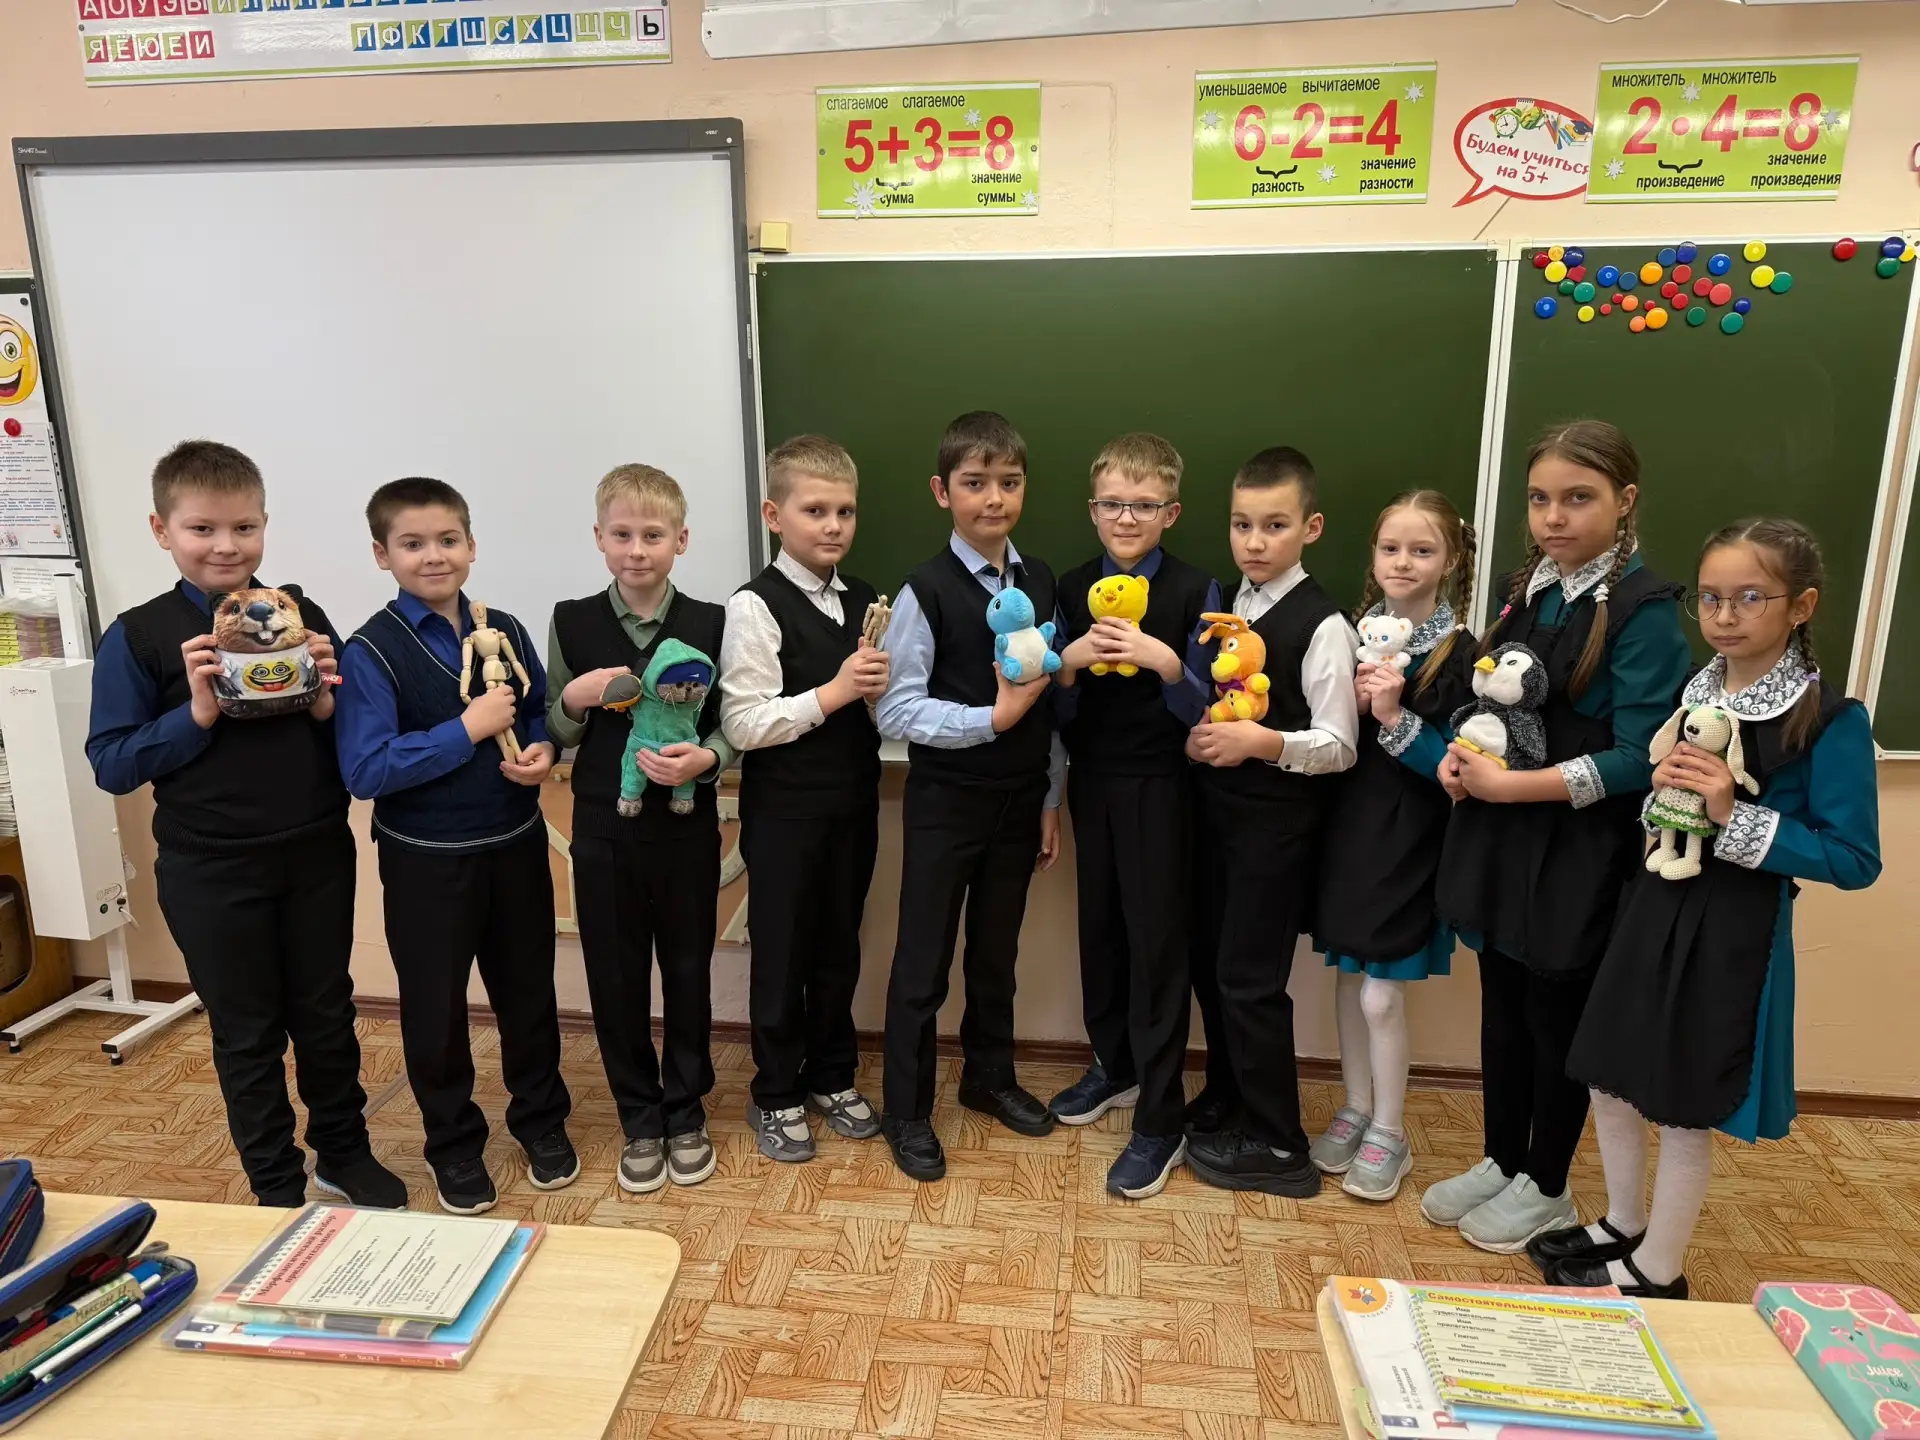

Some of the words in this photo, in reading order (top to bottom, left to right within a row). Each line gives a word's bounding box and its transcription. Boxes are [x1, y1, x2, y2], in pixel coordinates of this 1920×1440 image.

[1612, 72, 1686, 88] множитель
[1701, 70, 1777, 86] множитель
[1199, 81, 1288, 101] уменьшаемое
[1302, 78, 1380, 94] вычитаемое
[826, 97, 889, 111] слагаемое
[902, 94, 965, 109] слагаемое
[1466, 133, 1519, 158] Будем
[1360, 157, 1416, 170] значение
[1767, 152, 1827, 165] значение
[971, 171, 1022, 184] значение
[1496, 165, 1518, 179] на
[1251, 179, 1305, 196] разность
[1359, 176, 1414, 193] разности
[1636, 173, 1725, 191] произведение
[1750, 173, 1841, 189] произведения
[879, 192, 914, 207] сумма
[977, 191, 1016, 206] суммы
[1428, 1292, 1545, 1312] Самостоятельные
[1548, 1307, 1587, 1317] части
[1591, 1311, 1622, 1320] речи
